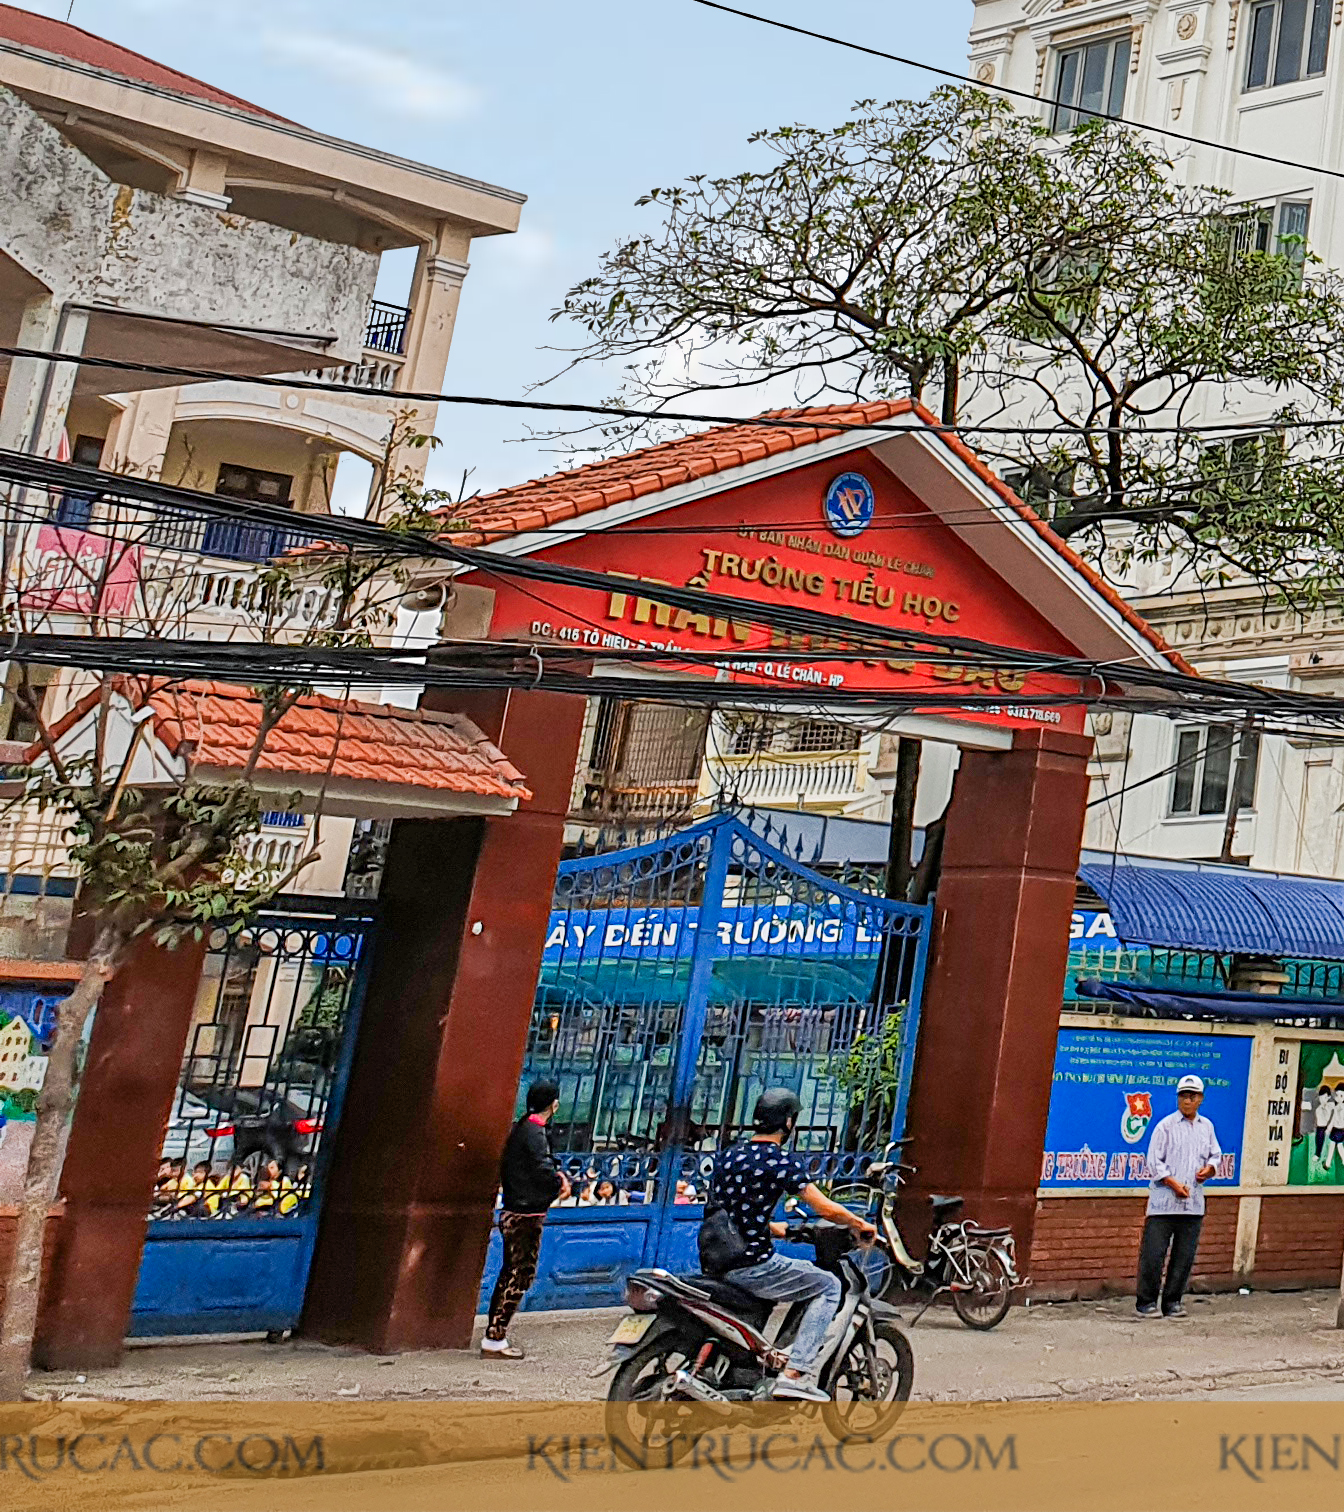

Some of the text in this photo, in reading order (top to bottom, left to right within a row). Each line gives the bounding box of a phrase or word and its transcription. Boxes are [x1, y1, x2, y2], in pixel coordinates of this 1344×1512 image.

[702, 547, 961, 625] TRƯỜNG TIỂU HỌC
[828, 673, 844, 687] HP
[1267, 1096, 1291, 1116] TRÊN
